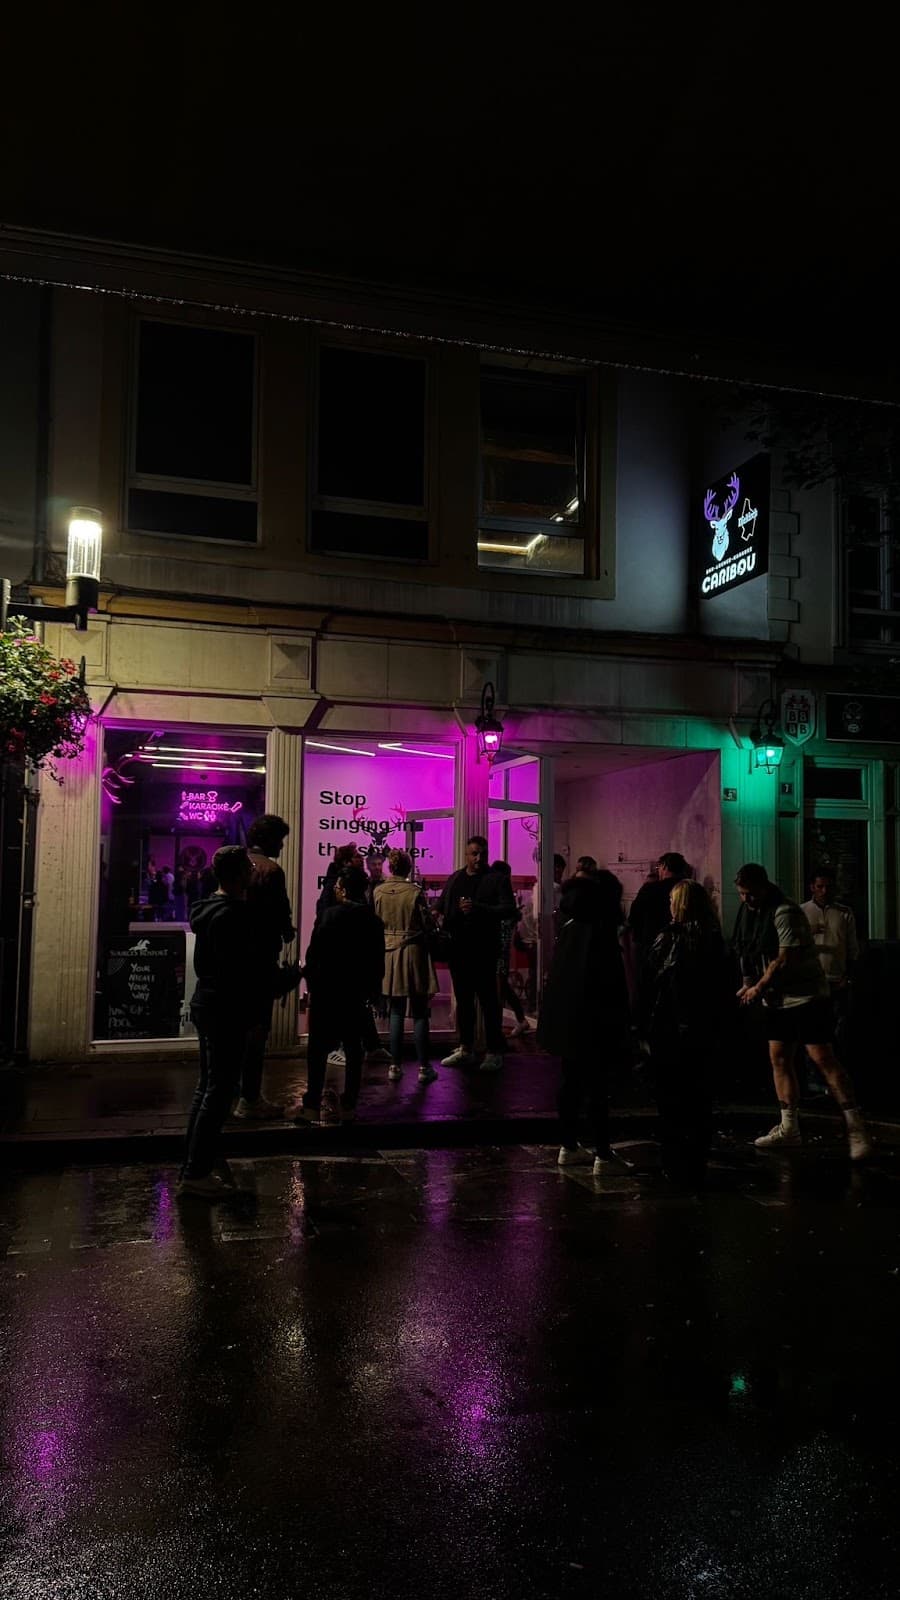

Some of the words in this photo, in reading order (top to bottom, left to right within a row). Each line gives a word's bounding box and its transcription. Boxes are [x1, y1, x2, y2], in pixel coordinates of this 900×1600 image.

[702, 552, 756, 593] CARIBOU
[188, 792, 206, 801] BAR
[319, 790, 367, 809] Stop
[188, 812, 203, 820] WC
[319, 816, 390, 834] singing
